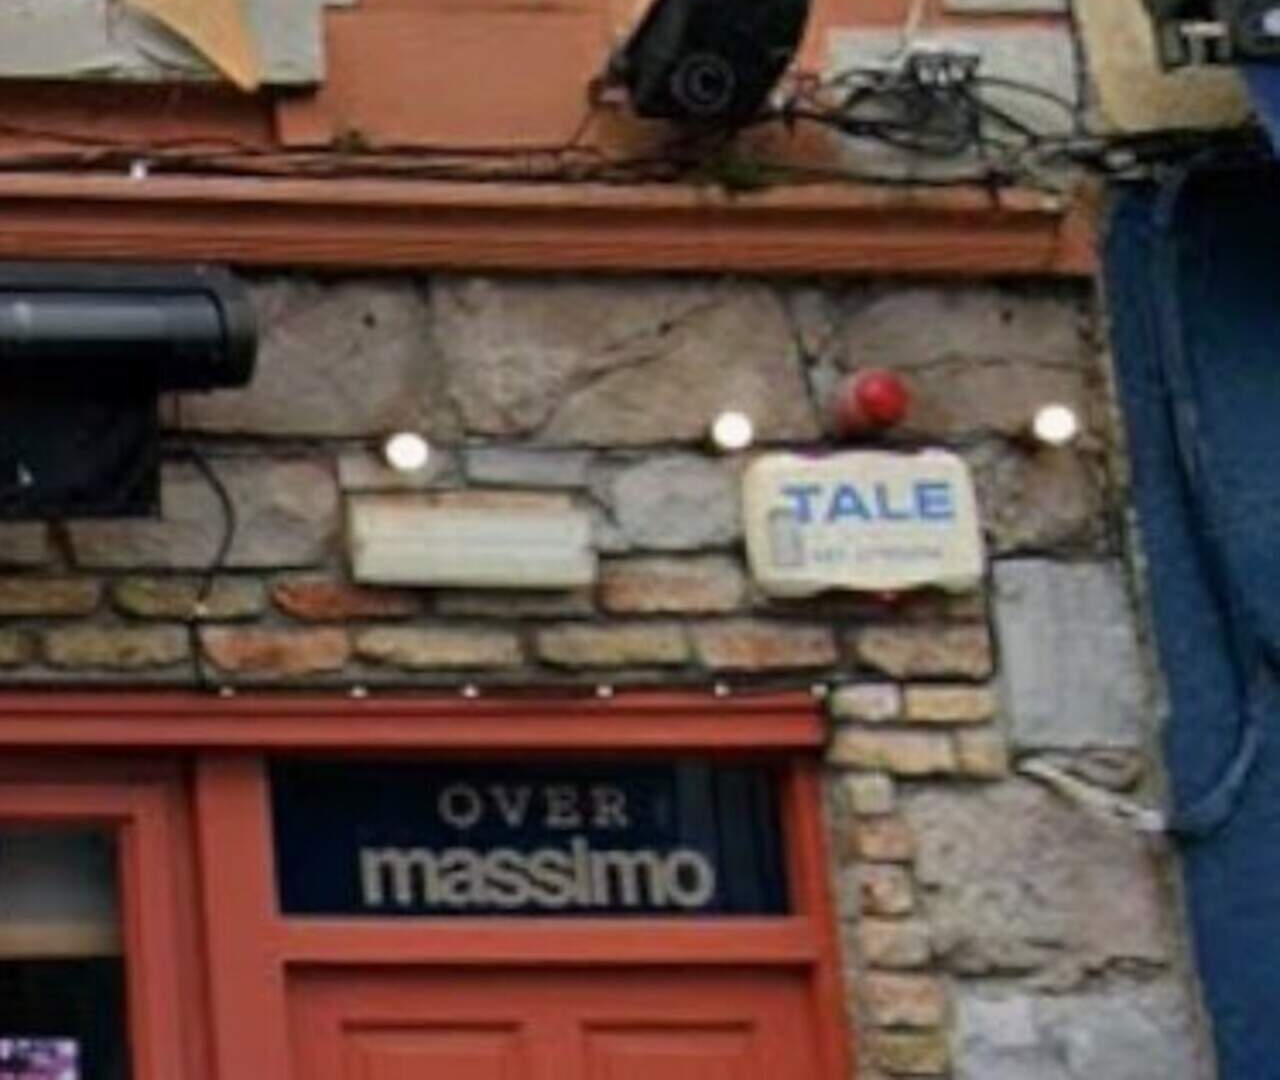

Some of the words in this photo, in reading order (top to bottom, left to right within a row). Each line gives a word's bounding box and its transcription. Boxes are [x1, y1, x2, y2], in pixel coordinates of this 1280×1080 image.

[779, 480, 956, 524] TALE
[439, 784, 630, 828] OVER
[359, 834, 716, 909] massimo
